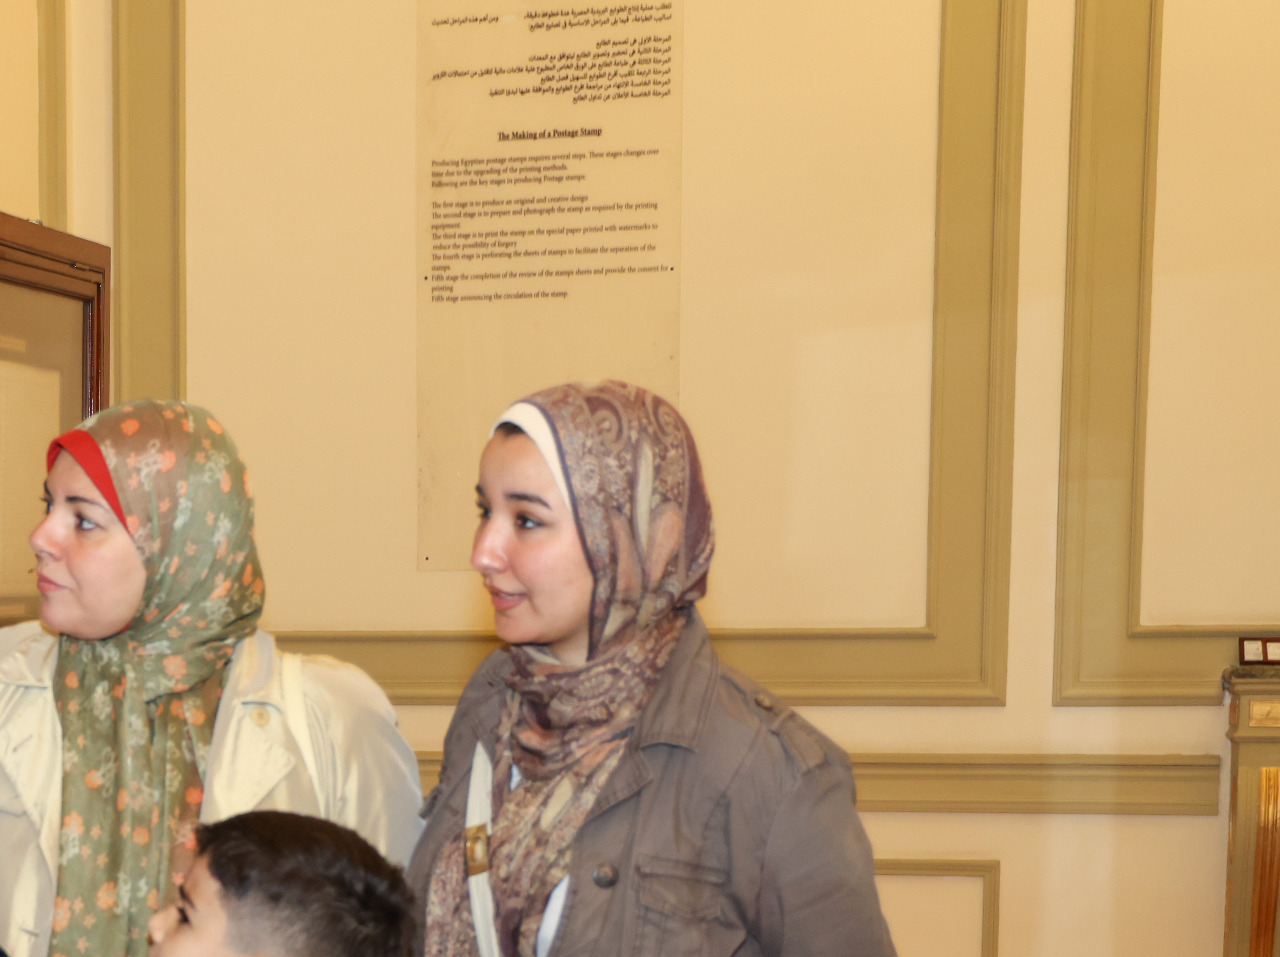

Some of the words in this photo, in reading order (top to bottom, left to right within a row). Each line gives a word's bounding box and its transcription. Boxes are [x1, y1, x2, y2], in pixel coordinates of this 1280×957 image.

[498, 132, 510, 140] The
[511, 131, 537, 140] Making
[538, 130, 546, 138] of
[553, 130, 578, 139] Postage
[580, 129, 602, 137] Stamp
[431, 159, 460, 167] Producing
[460, 158, 485, 167] Egyptian
[486, 157, 507, 166] postage
[508, 156, 527, 164] stamps
[528, 155, 550, 163] requires
[606, 151, 622, 159] stages
[623, 149, 645, 158] changes
[473, 167, 501, 177] upgrading
[519, 165, 542, 174] printing
[431, 180, 458, 188] Following
[478, 179, 488, 187] key
[489, 178, 506, 186] stages
[514, 176, 542, 185] producing
[543, 175, 564, 183] Postage
[455, 201, 468, 209] stage
[481, 199, 504, 208] produce
[513, 197, 535, 206] original
[462, 211, 476, 219] stage
[490, 210, 511, 218] prepare
[523, 207, 555, 217] photograph
[567, 206, 583, 214] stamp
[592, 204, 615, 213] required
[616, 204, 623, 212] by
[634, 203, 658, 212] printing
[457, 232, 471, 240] stage
[484, 230, 498, 239] print
[546, 227, 565, 236] special
[582, 225, 603, 235] printed
[618, 223, 650, 231] watermarks
[462, 242, 489, 251] possibility
[461, 253, 474, 261] stage
[481, 251, 512, 260] perforating
[610, 245, 639, 254] separation
[445, 274, 459, 282] stage
[470, 273, 501, 281] completion
[555, 270, 574, 278] stamps
[605, 267, 626, 276] provide
[431, 285, 453, 294] printing
[446, 295, 459, 303] stage
[460, 294, 493, 302] announcing
